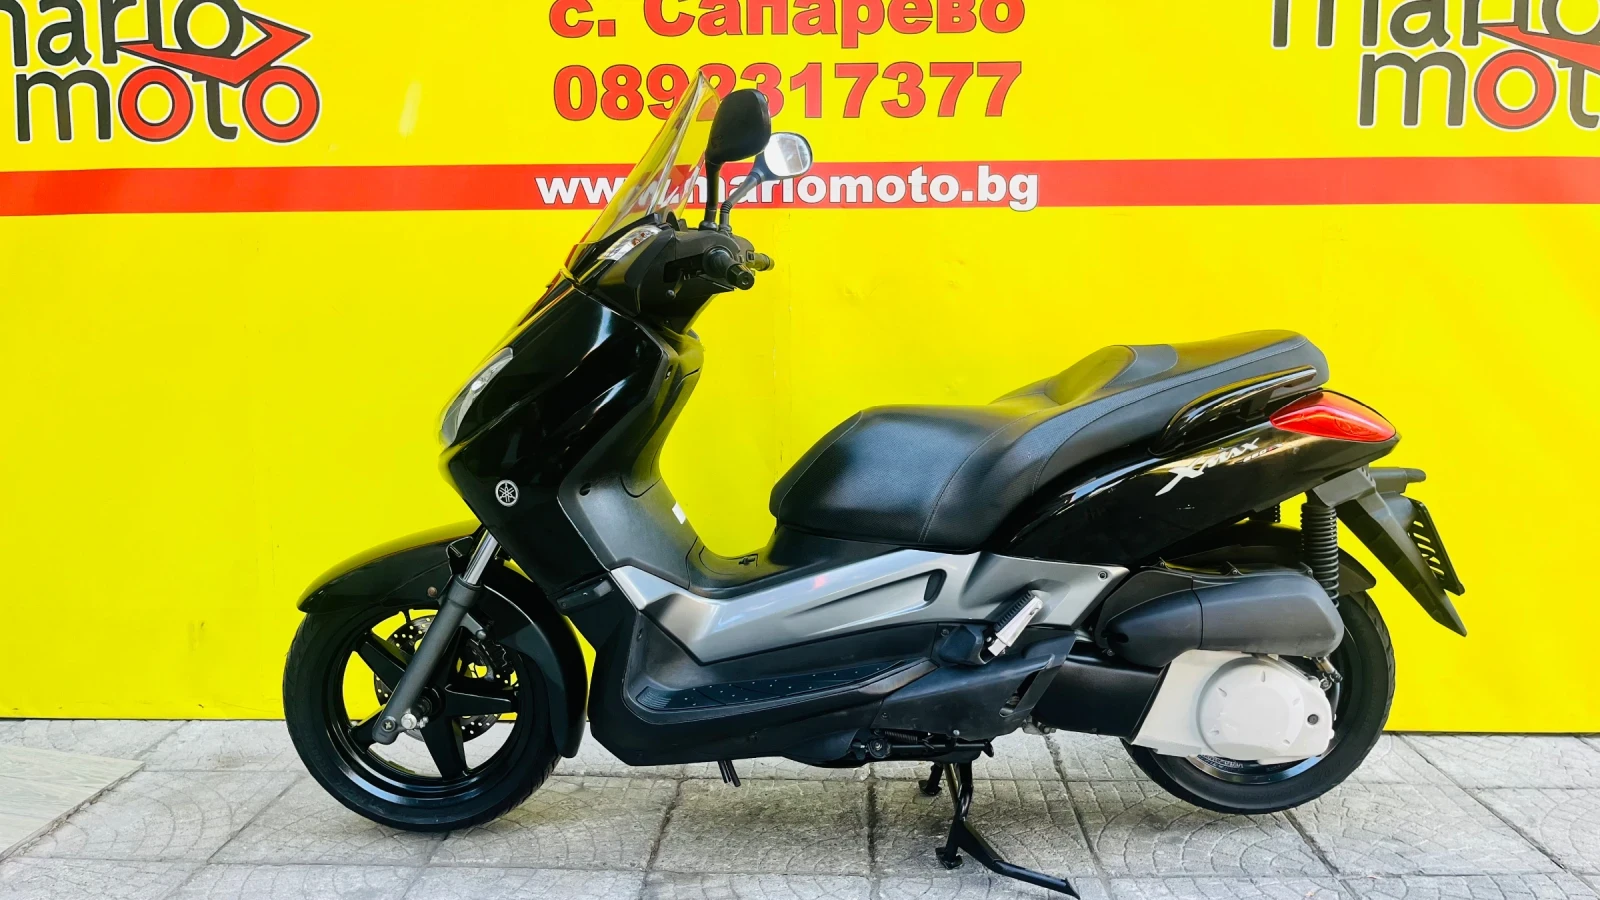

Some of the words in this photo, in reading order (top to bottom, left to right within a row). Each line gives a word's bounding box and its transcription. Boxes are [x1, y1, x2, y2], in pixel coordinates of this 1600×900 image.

[0, 0, 245, 66] ario
[643, 0, 1025, 49] Сапарево
[15, 65, 320, 143] moto
